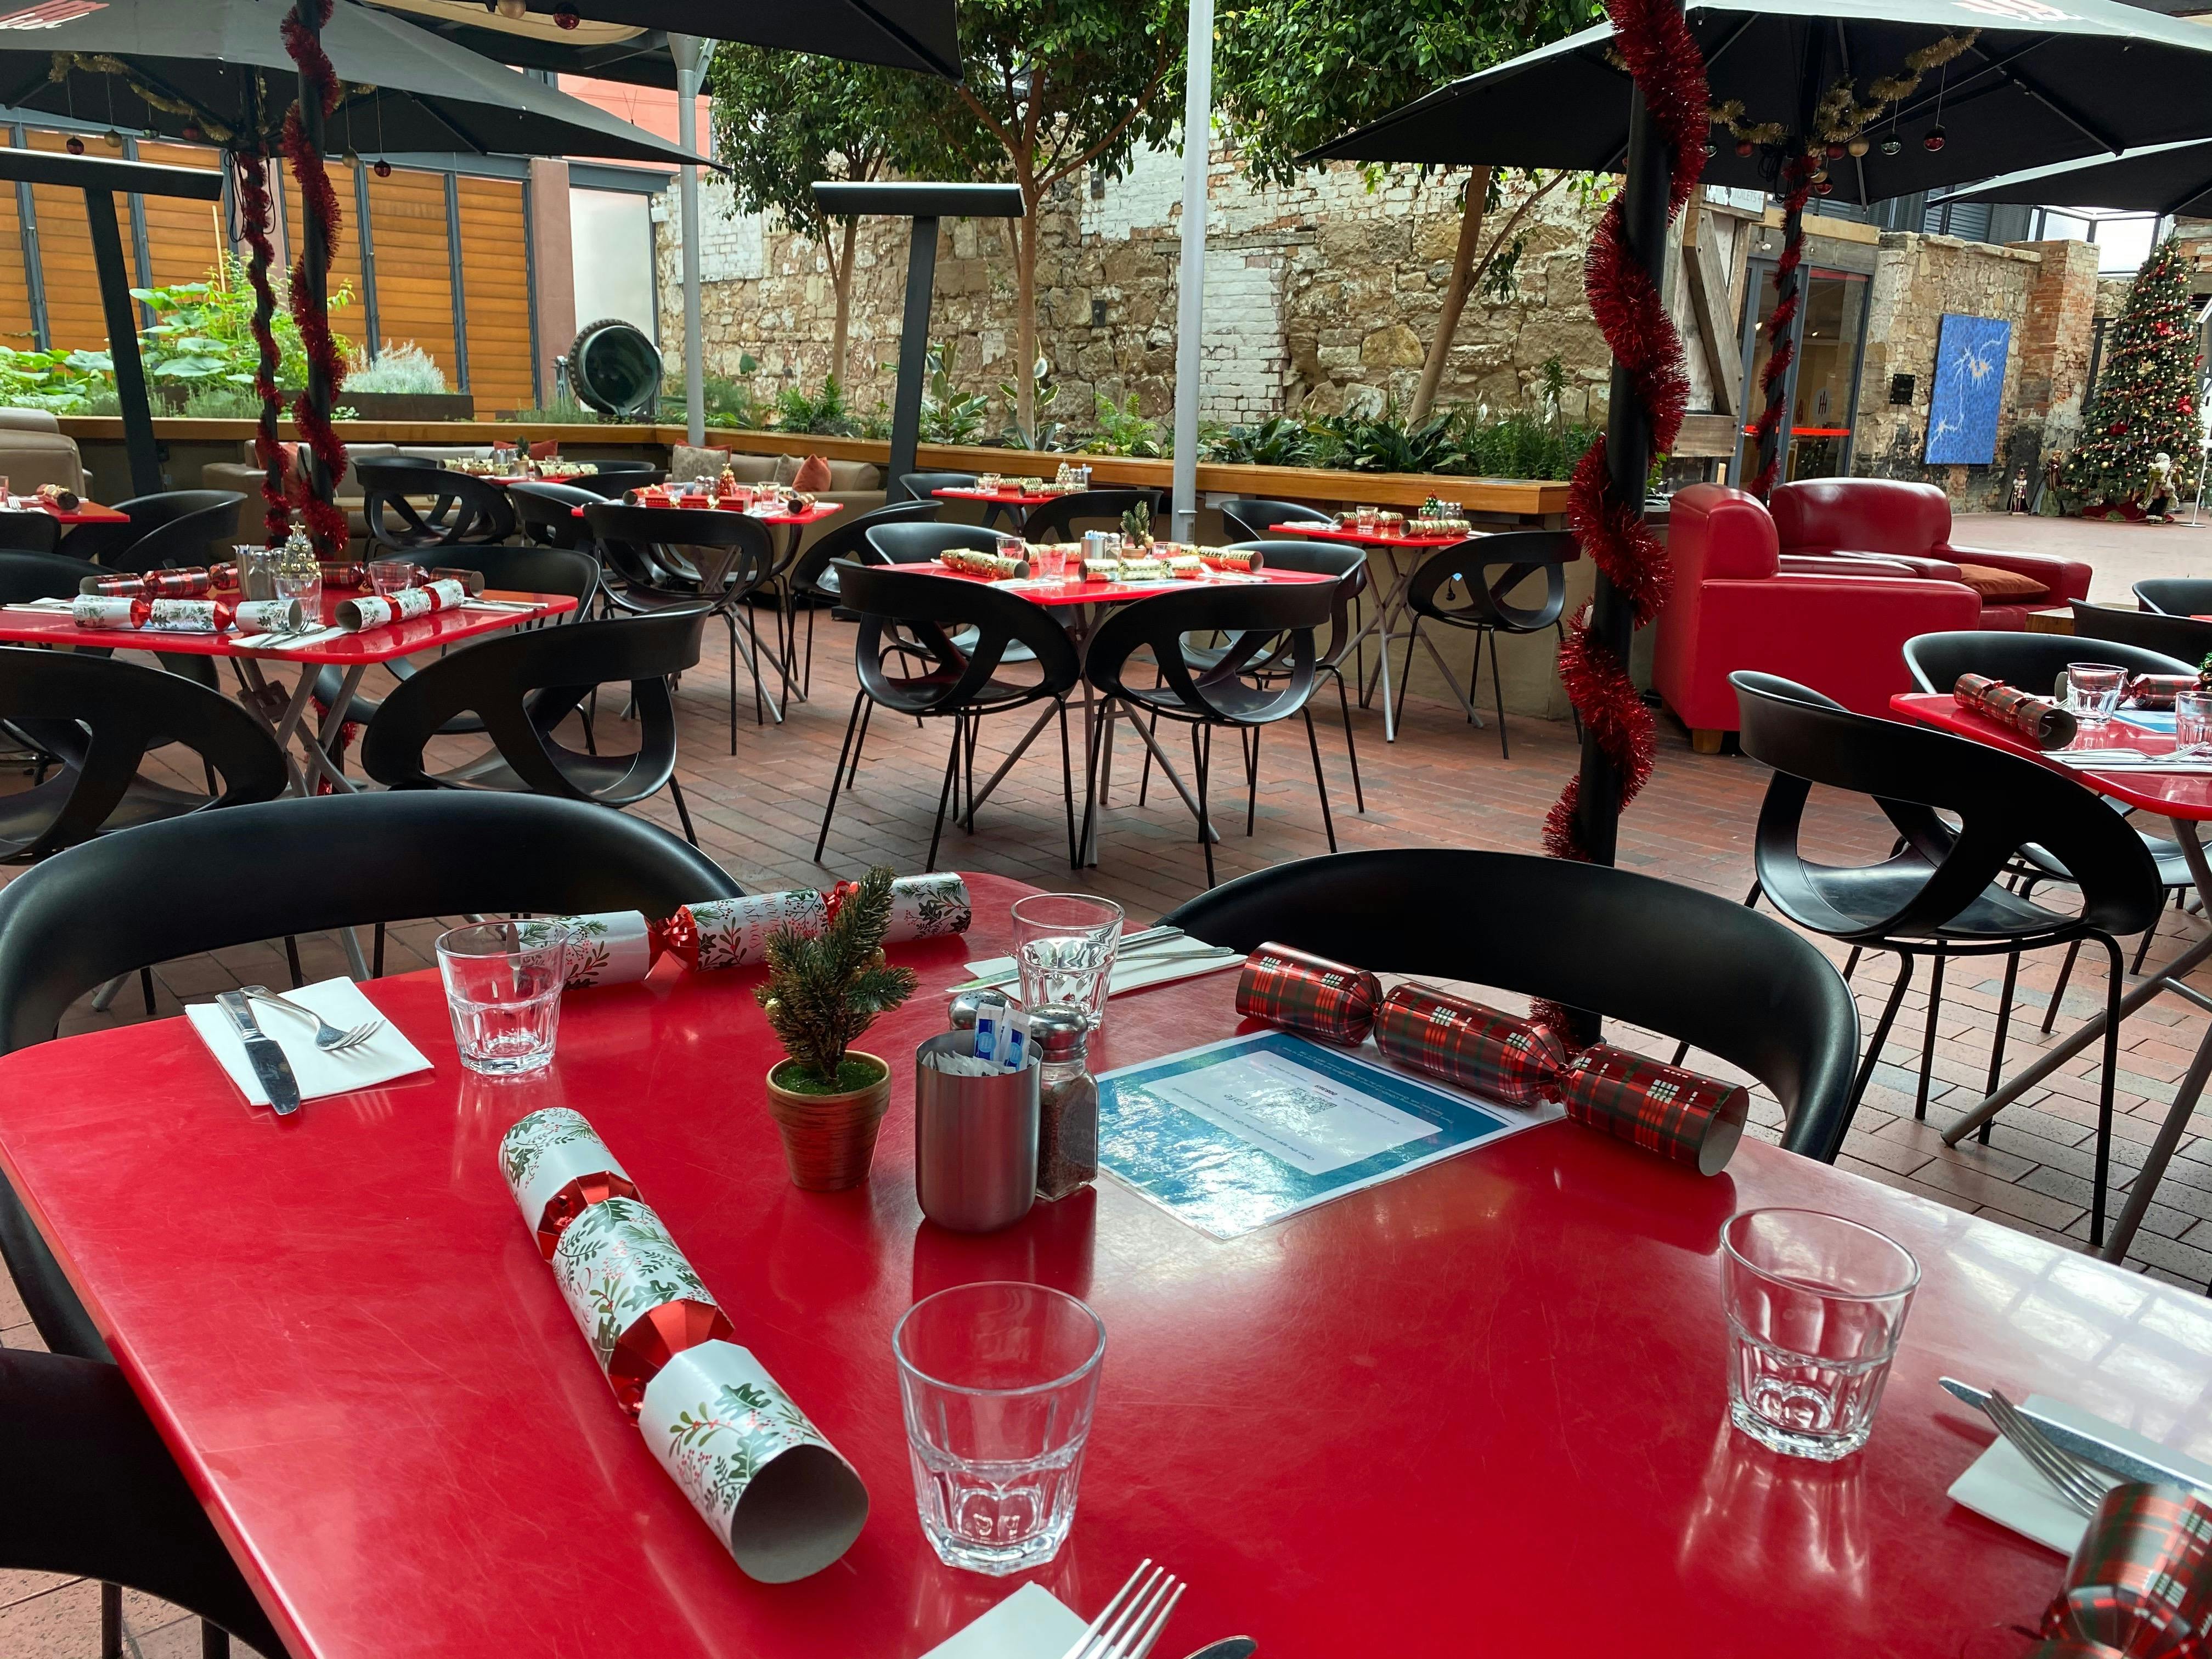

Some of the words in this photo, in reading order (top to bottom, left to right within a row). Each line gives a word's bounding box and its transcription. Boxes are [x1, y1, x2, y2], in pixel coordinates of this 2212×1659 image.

[1734, 189, 1757, 202] TOILETS
[737, 896, 763, 951] ristmas
[1224, 1094, 1248, 1106] Cafe
